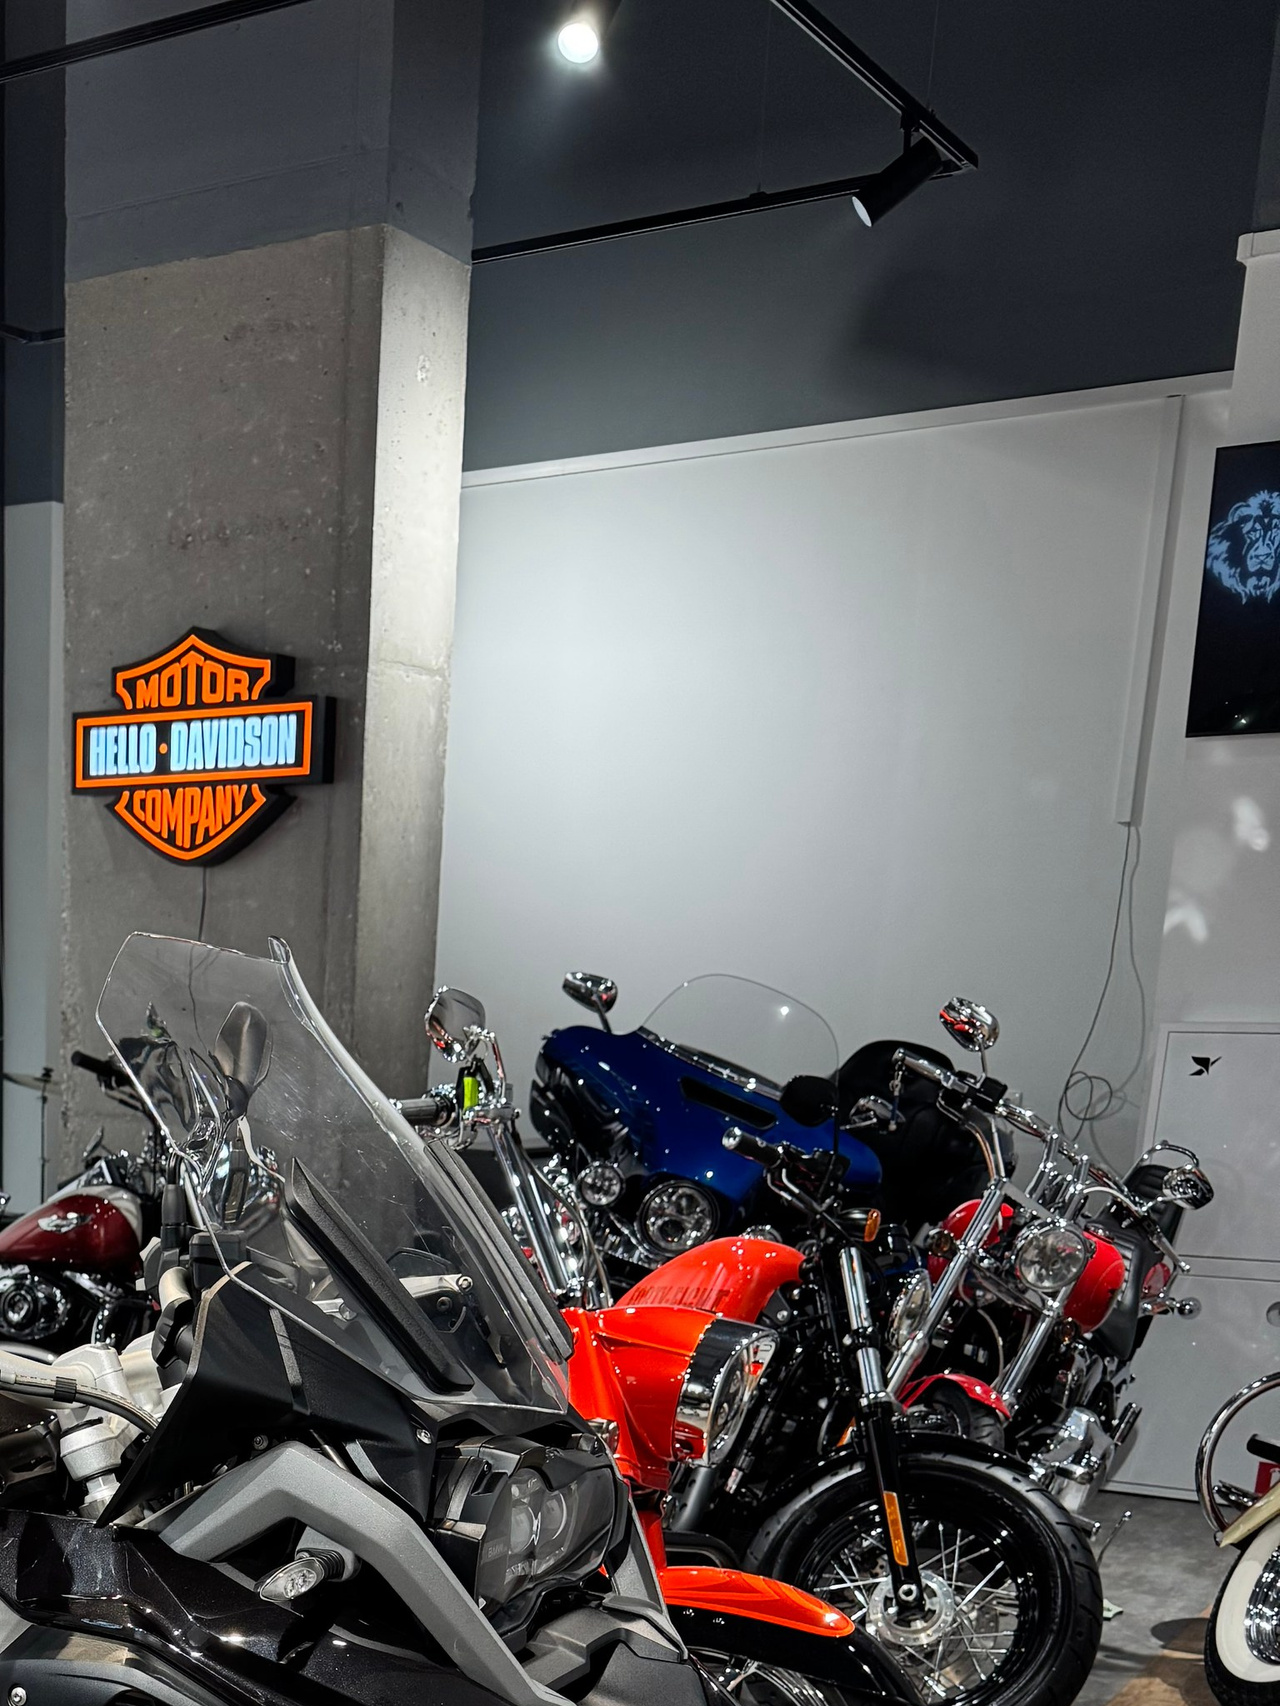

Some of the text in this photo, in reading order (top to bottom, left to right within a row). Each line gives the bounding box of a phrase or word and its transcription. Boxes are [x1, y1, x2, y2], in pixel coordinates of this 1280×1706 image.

[135, 650, 250, 709] MOTOR
[89, 713, 298, 776] HELLO DAVIDSON
[132, 783, 248, 849] COMPANY
